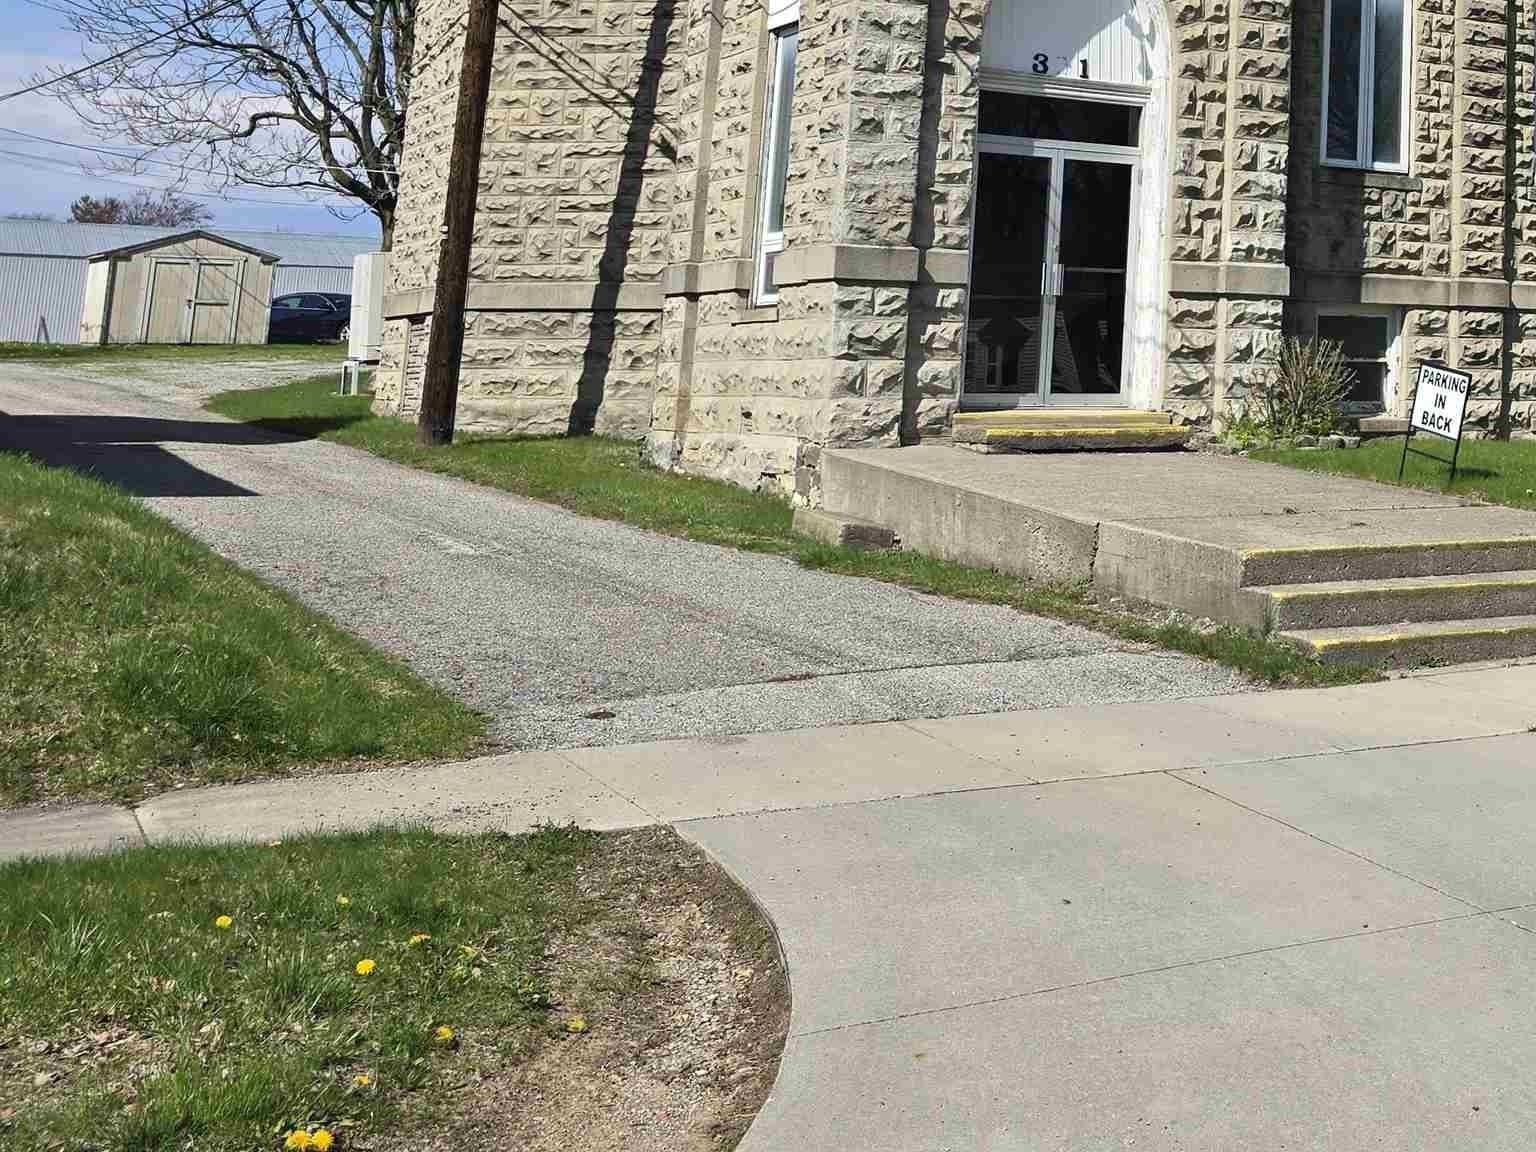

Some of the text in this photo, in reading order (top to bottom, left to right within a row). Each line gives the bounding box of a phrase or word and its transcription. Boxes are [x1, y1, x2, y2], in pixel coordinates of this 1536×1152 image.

[1422, 369, 1467, 394] PARKING
[1434, 393, 1446, 409] IN
[1421, 410, 1453, 433] BACK
